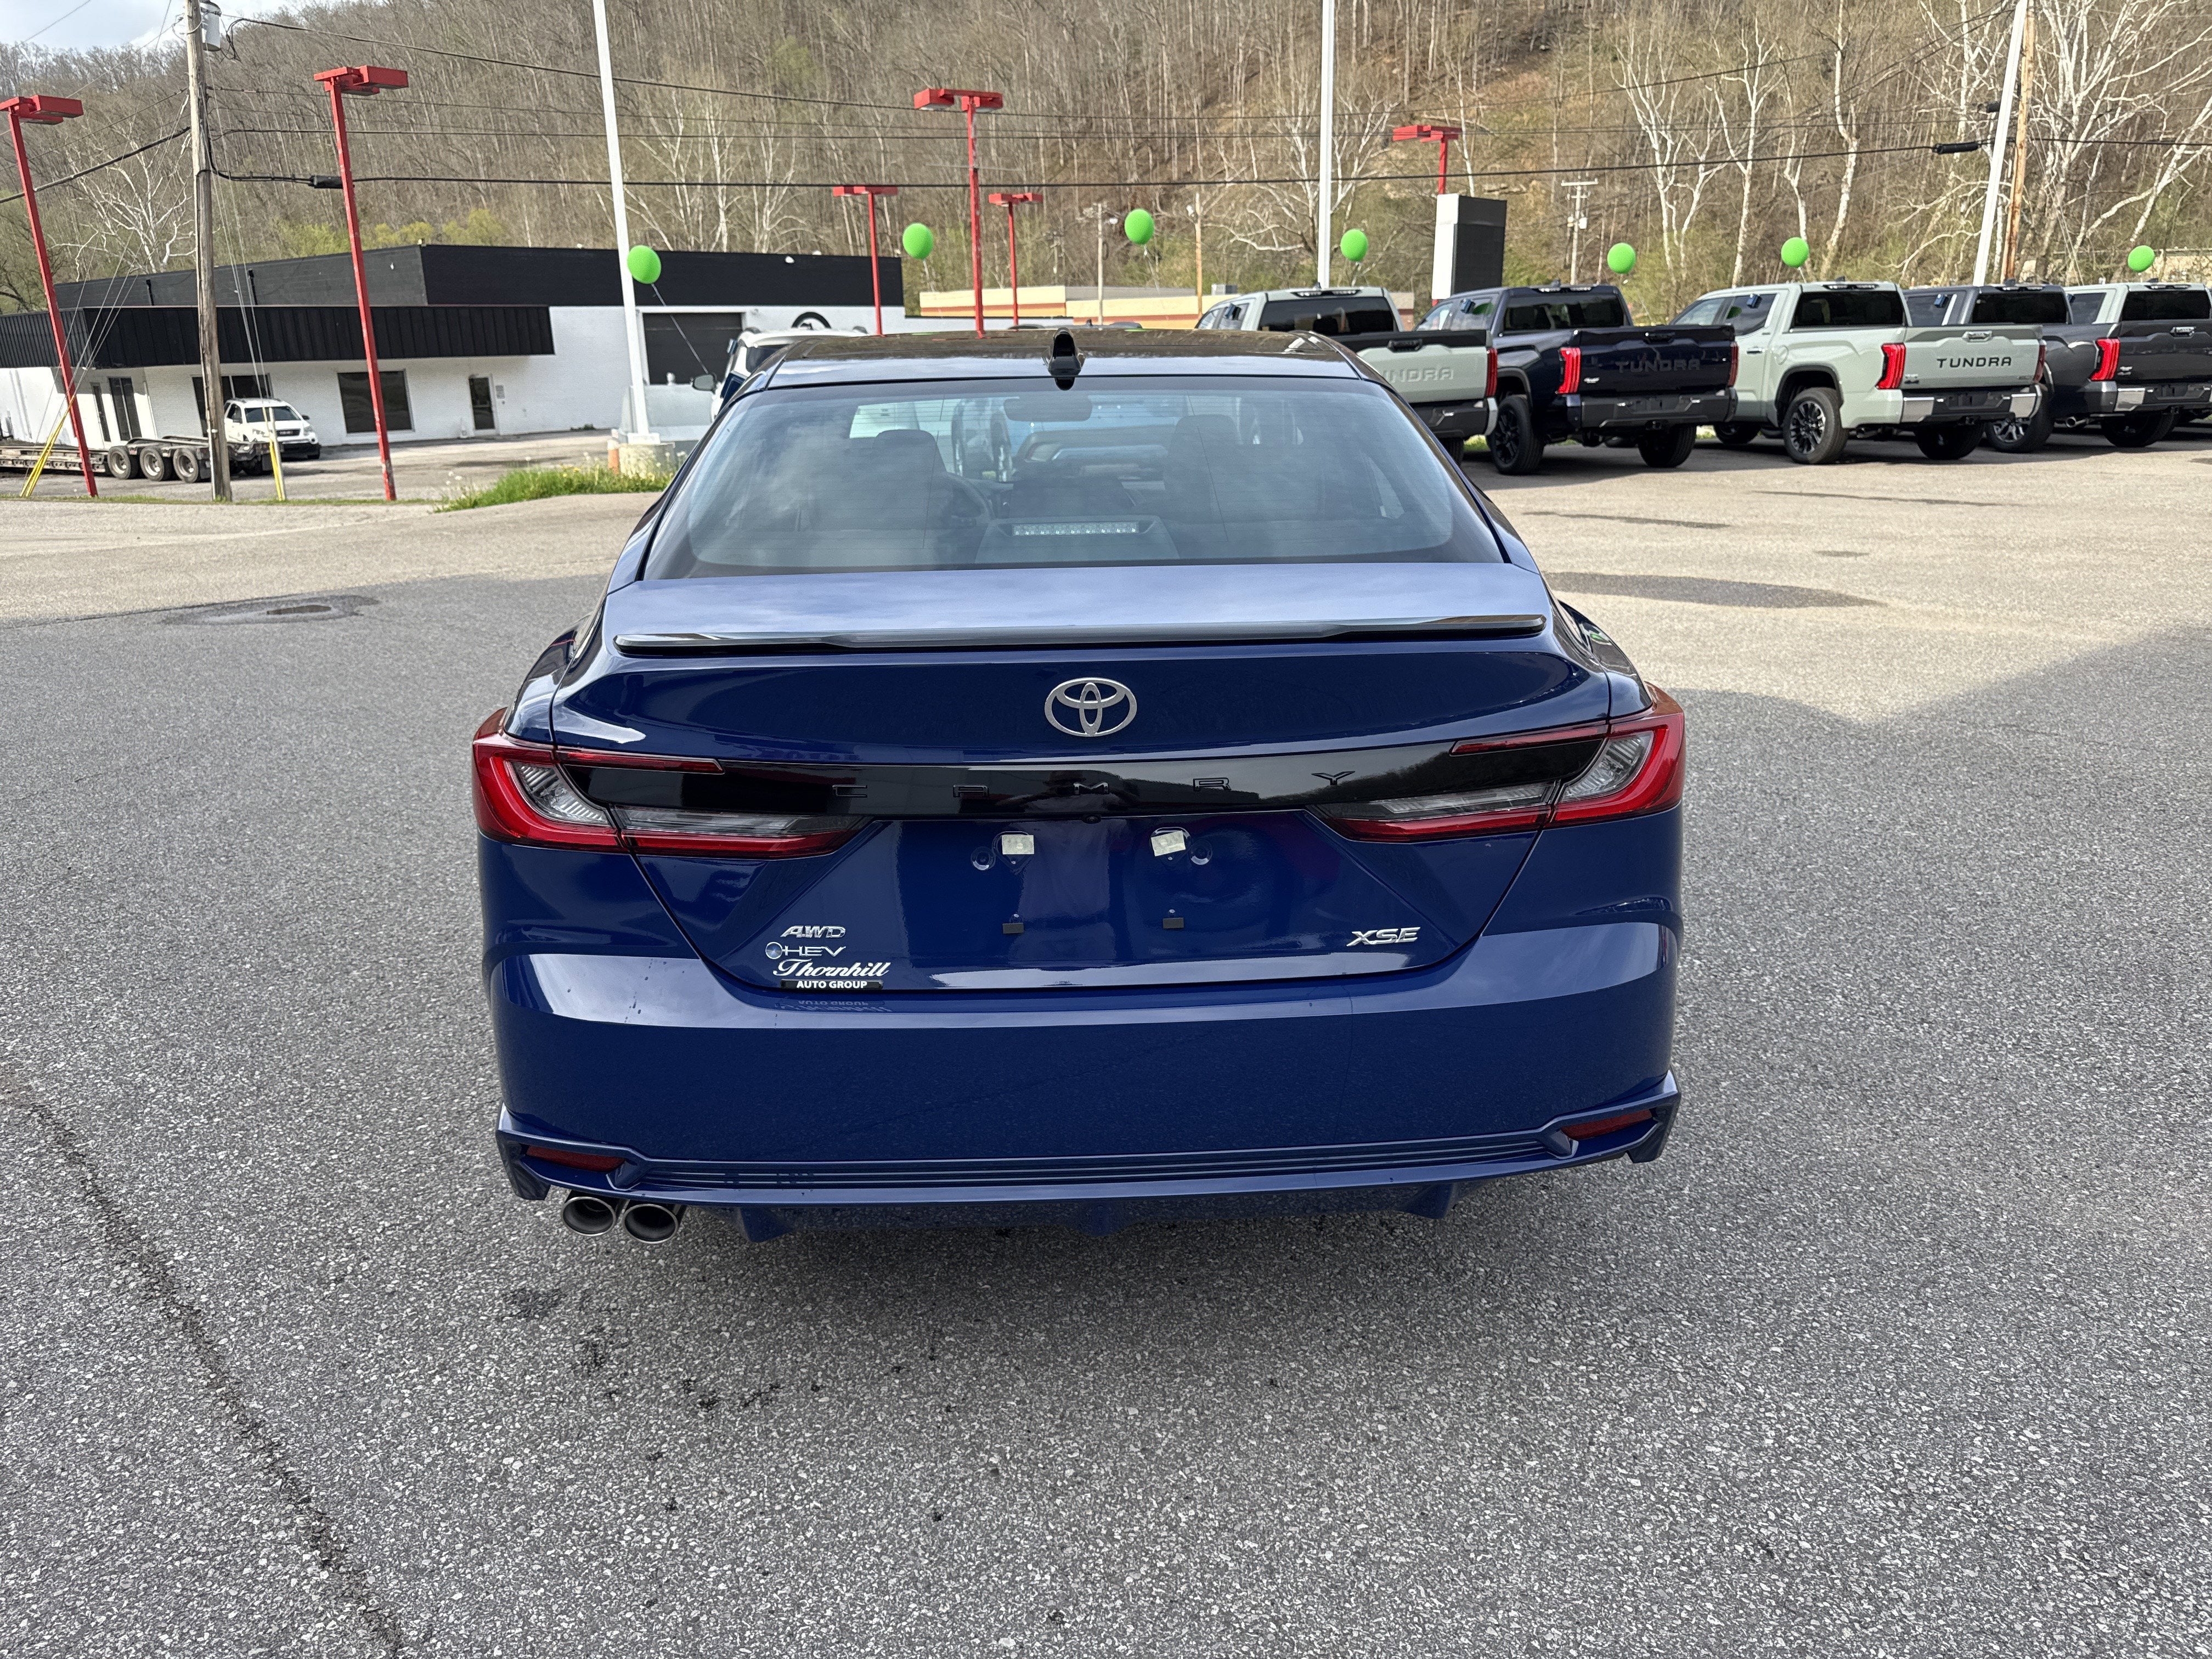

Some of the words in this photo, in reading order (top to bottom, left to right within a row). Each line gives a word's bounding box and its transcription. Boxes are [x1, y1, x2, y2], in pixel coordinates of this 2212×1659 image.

[1615, 358, 1700, 373] TUNDRA
[1937, 357, 2012, 368] TUNDRA
[832, 770, 1356, 798] CAMRY
[780, 926, 846, 938] AWD
[1346, 927, 1421, 946] XSE
[782, 945, 847, 957] HEV
[772, 958, 891, 977] Thornhill
[796, 980, 827, 989] AUTO
[828, 980, 867, 989] GROUP
